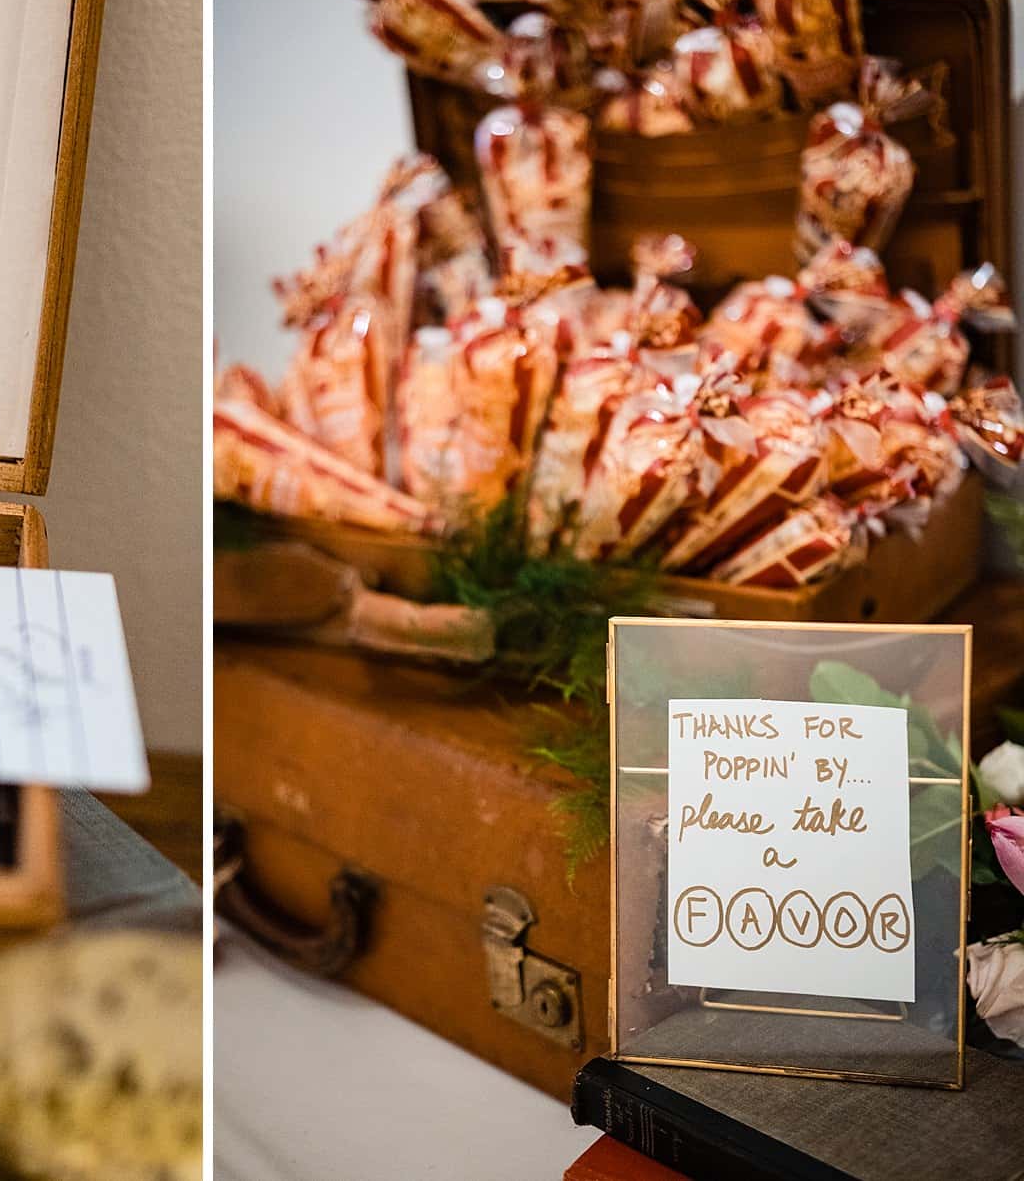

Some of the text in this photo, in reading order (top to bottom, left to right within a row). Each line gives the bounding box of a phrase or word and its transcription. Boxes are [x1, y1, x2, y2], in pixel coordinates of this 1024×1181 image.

[673, 713, 863, 739] THANKS FOR
[704, 750, 795, 781] POPPIN'
[678, 793, 868, 843] please take
[763, 847, 798, 869] a
[674, 885, 911, 953] FAVOR
